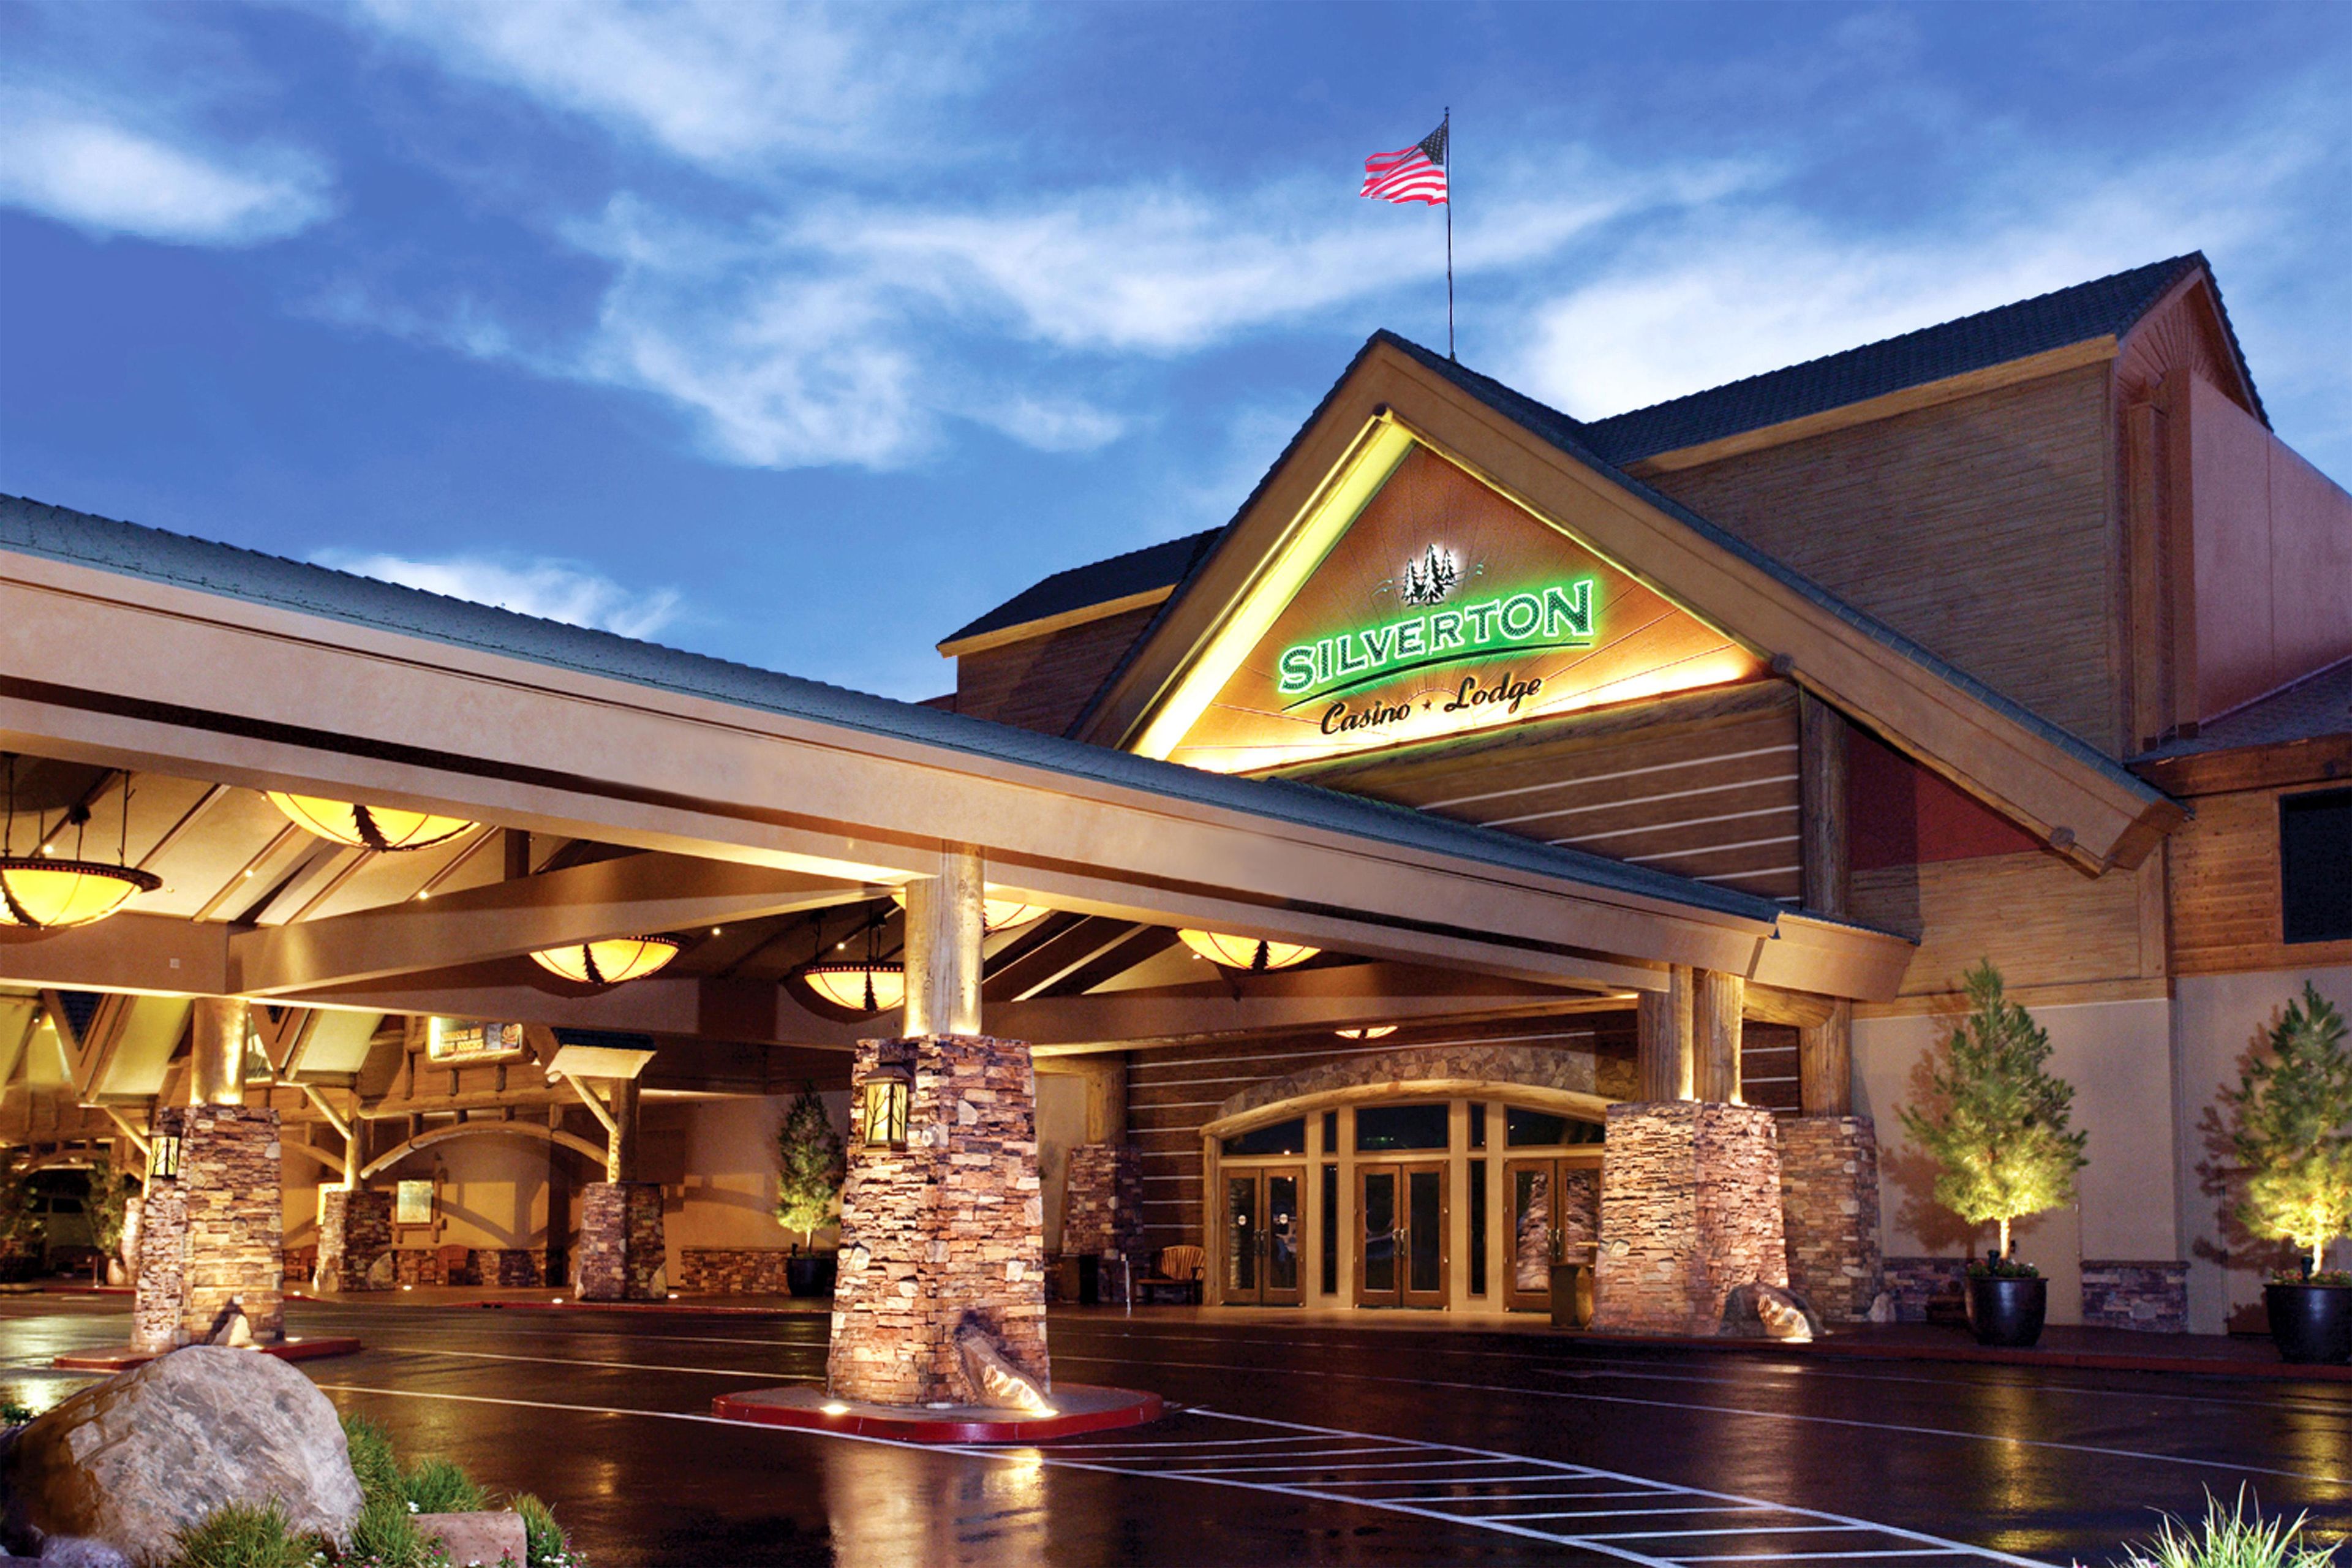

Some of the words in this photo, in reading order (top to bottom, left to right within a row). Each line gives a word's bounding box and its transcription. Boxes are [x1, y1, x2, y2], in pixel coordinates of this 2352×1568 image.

[1278, 579, 1593, 694] SILVERTON
[1321, 701, 1411, 735] Casino
[1444, 673, 1542, 714] Lodge
